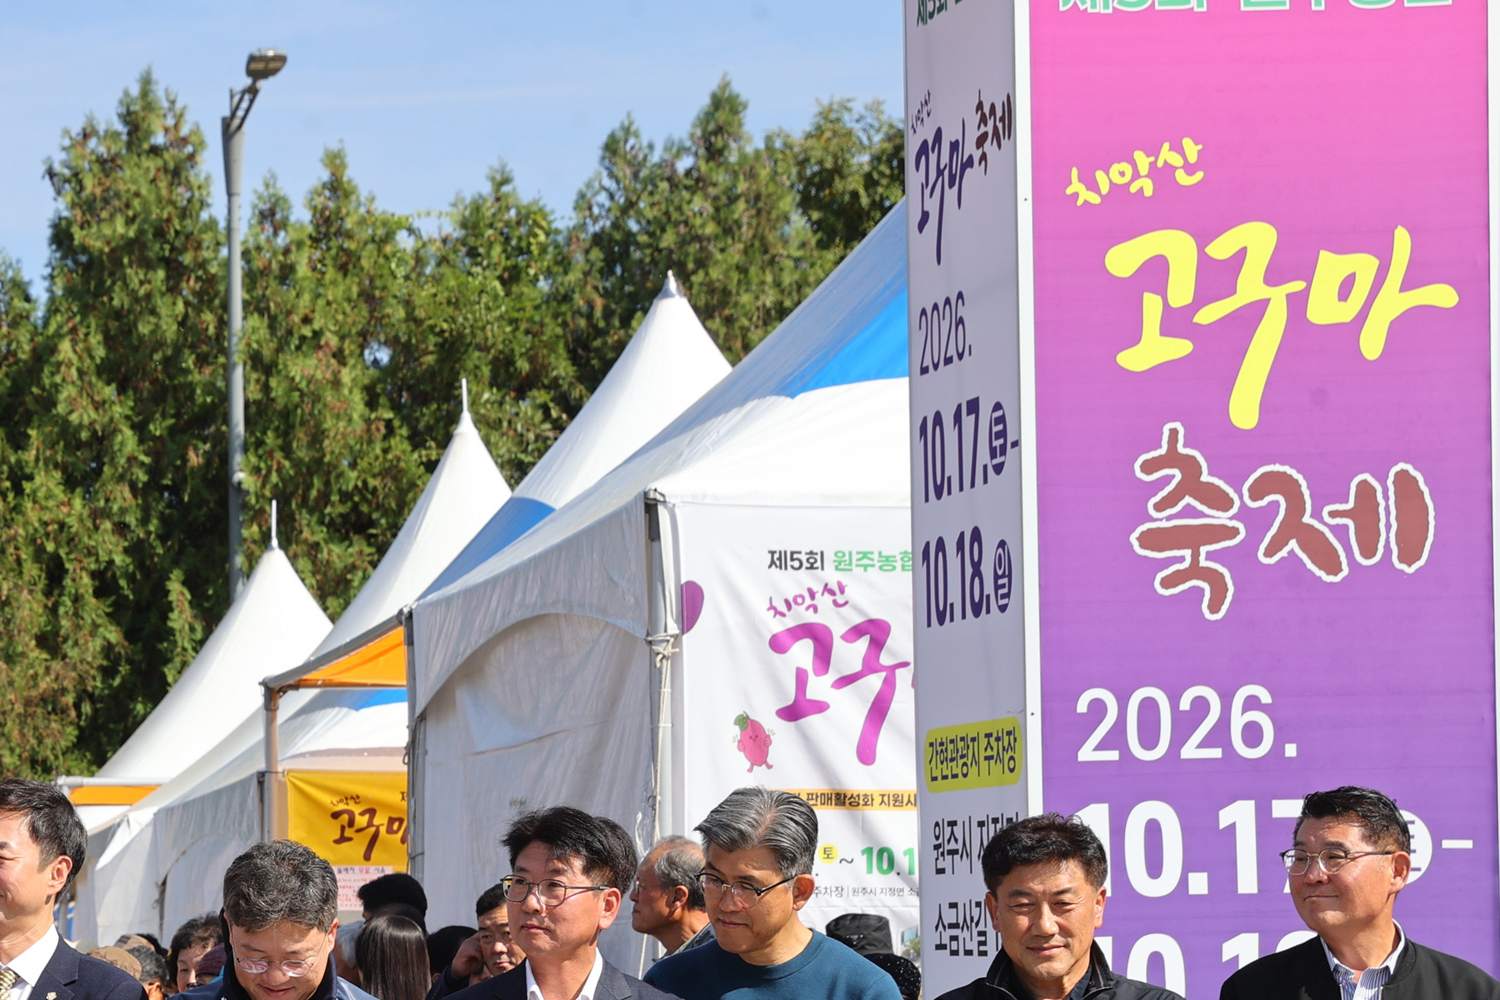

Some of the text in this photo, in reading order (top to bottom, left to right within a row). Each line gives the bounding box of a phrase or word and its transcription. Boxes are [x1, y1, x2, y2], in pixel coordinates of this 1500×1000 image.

[911, 89, 932, 135] 치악산
[975, 89, 1013, 176] 축제
[915, 118, 974, 266] 고구마
[1065, 136, 1205, 207] 치악산
[918, 291, 972, 377] 2026.
[1104, 221, 1460, 430] 고구마
[1129, 421, 1436, 621] 축제
[767, 550, 825, 571] 제5회
[766, 580, 849, 618] 치악산
[768, 618, 914, 766] 고구
[1076, 684, 1298, 762] 2026.
[928, 726, 1018, 781] 간현관광지 주차장
[330, 793, 361, 807] 치악산
[806, 792, 874, 807] 판매활성화
[933, 815, 973, 875] 원주시
[814, 886, 919, 898] 주차장 원주시 지정면 소
[934, 898, 989, 957] 소금산길
